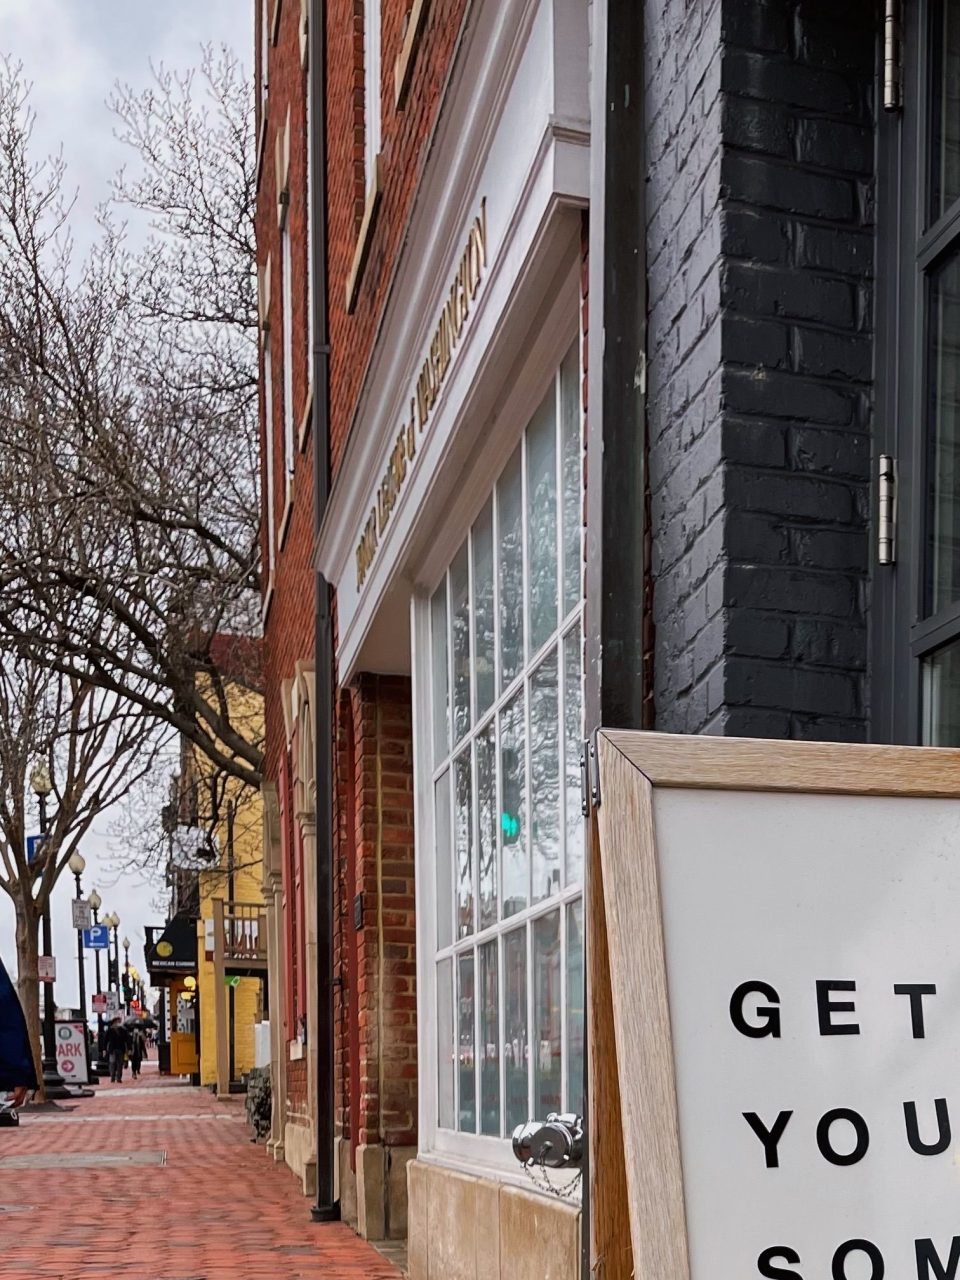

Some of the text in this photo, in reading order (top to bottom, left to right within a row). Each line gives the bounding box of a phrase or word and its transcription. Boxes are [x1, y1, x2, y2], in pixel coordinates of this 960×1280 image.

[417, 196, 487, 433] WASHINGTON
[90, 927, 102, 941] P
[729, 980, 937, 1039] GET
[56, 1043, 82, 1057] ARK
